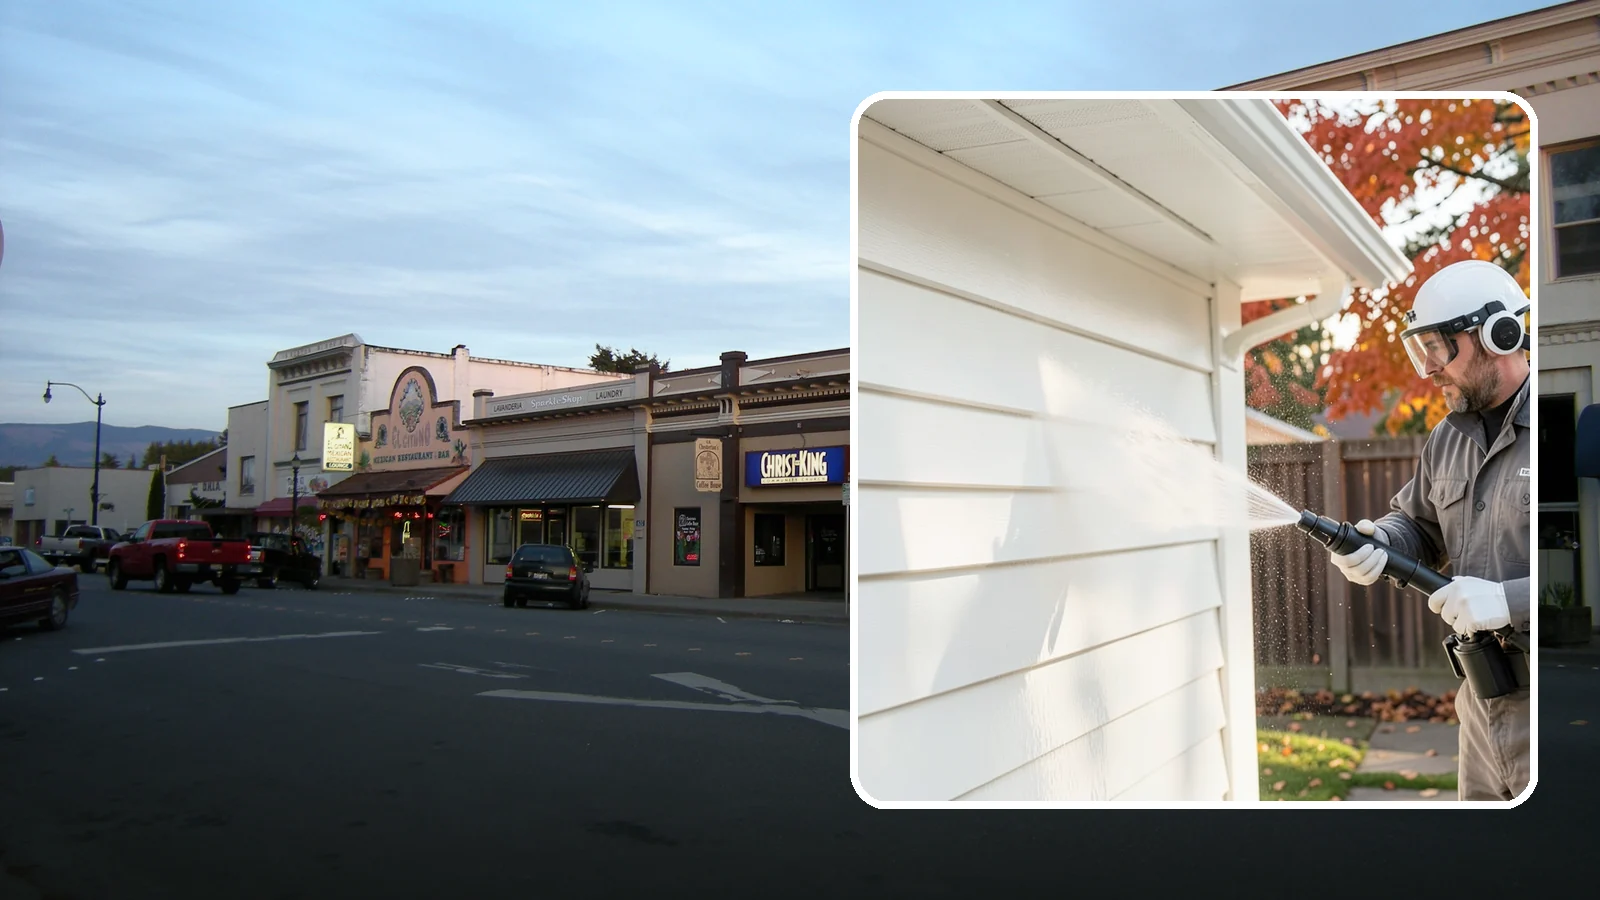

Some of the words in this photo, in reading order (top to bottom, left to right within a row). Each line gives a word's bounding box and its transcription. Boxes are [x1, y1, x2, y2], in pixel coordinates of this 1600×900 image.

[562, 394, 584, 407] Shop
[595, 388, 624, 400] LAUNDRY
[493, 402, 523, 413] LAVANDERIA
[373, 453, 396, 464] MEXICAN
[397, 451, 433, 463] RESTAURANT
[438, 450, 450, 459] BAR
[760, 452, 797, 478] CHRIST
[799, 450, 827, 476] KING
